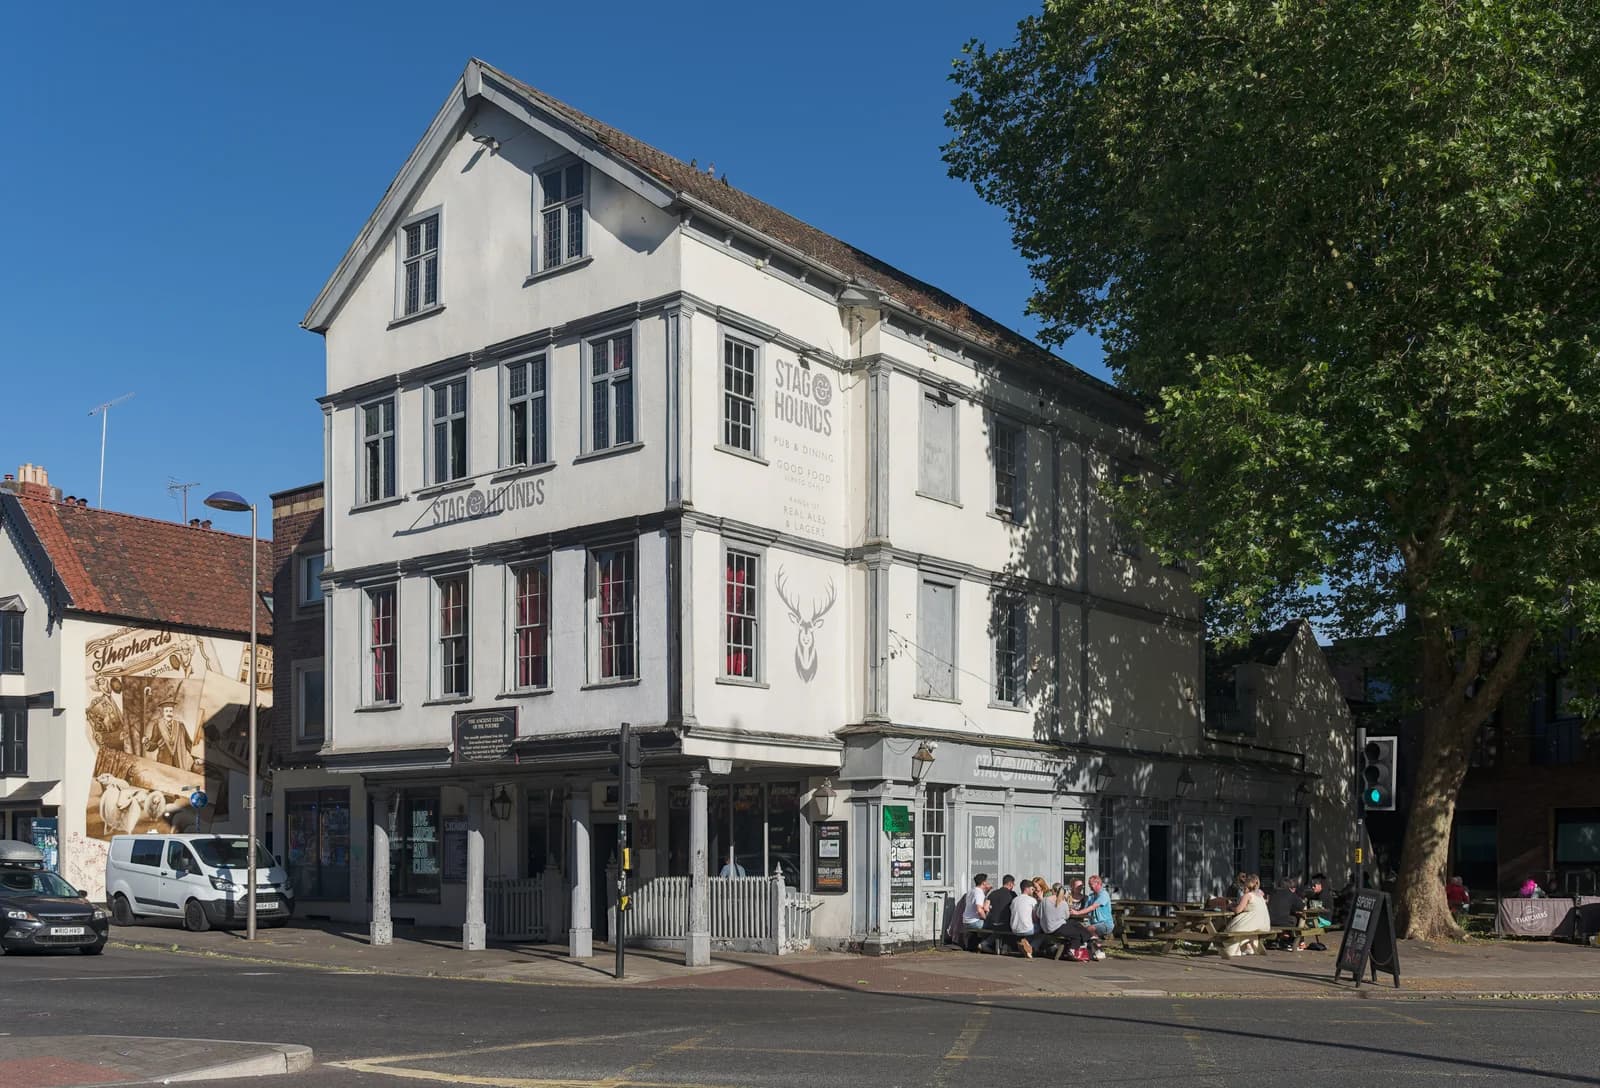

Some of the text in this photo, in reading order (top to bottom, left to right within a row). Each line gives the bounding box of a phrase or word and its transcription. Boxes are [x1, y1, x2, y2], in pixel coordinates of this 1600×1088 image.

[776, 358, 832, 406] STAG &
[775, 391, 832, 437] HOUNDS
[773, 435, 834, 464] PUB & DINING
[776, 459, 831, 484] GOOD FOOD
[433, 496, 465, 525] STAG
[486, 479, 545, 513] HOUNDS
[783, 504, 826, 526] REAL ALES
[794, 520, 825, 537] LAGERS
[973, 754, 1001, 779] STAG
[975, 825, 988, 837] STAG
[974, 838, 995, 849] HOUNDS
[1356, 895, 1376, 909] SPORT
[1515, 910, 1548, 924] THATCHERS
